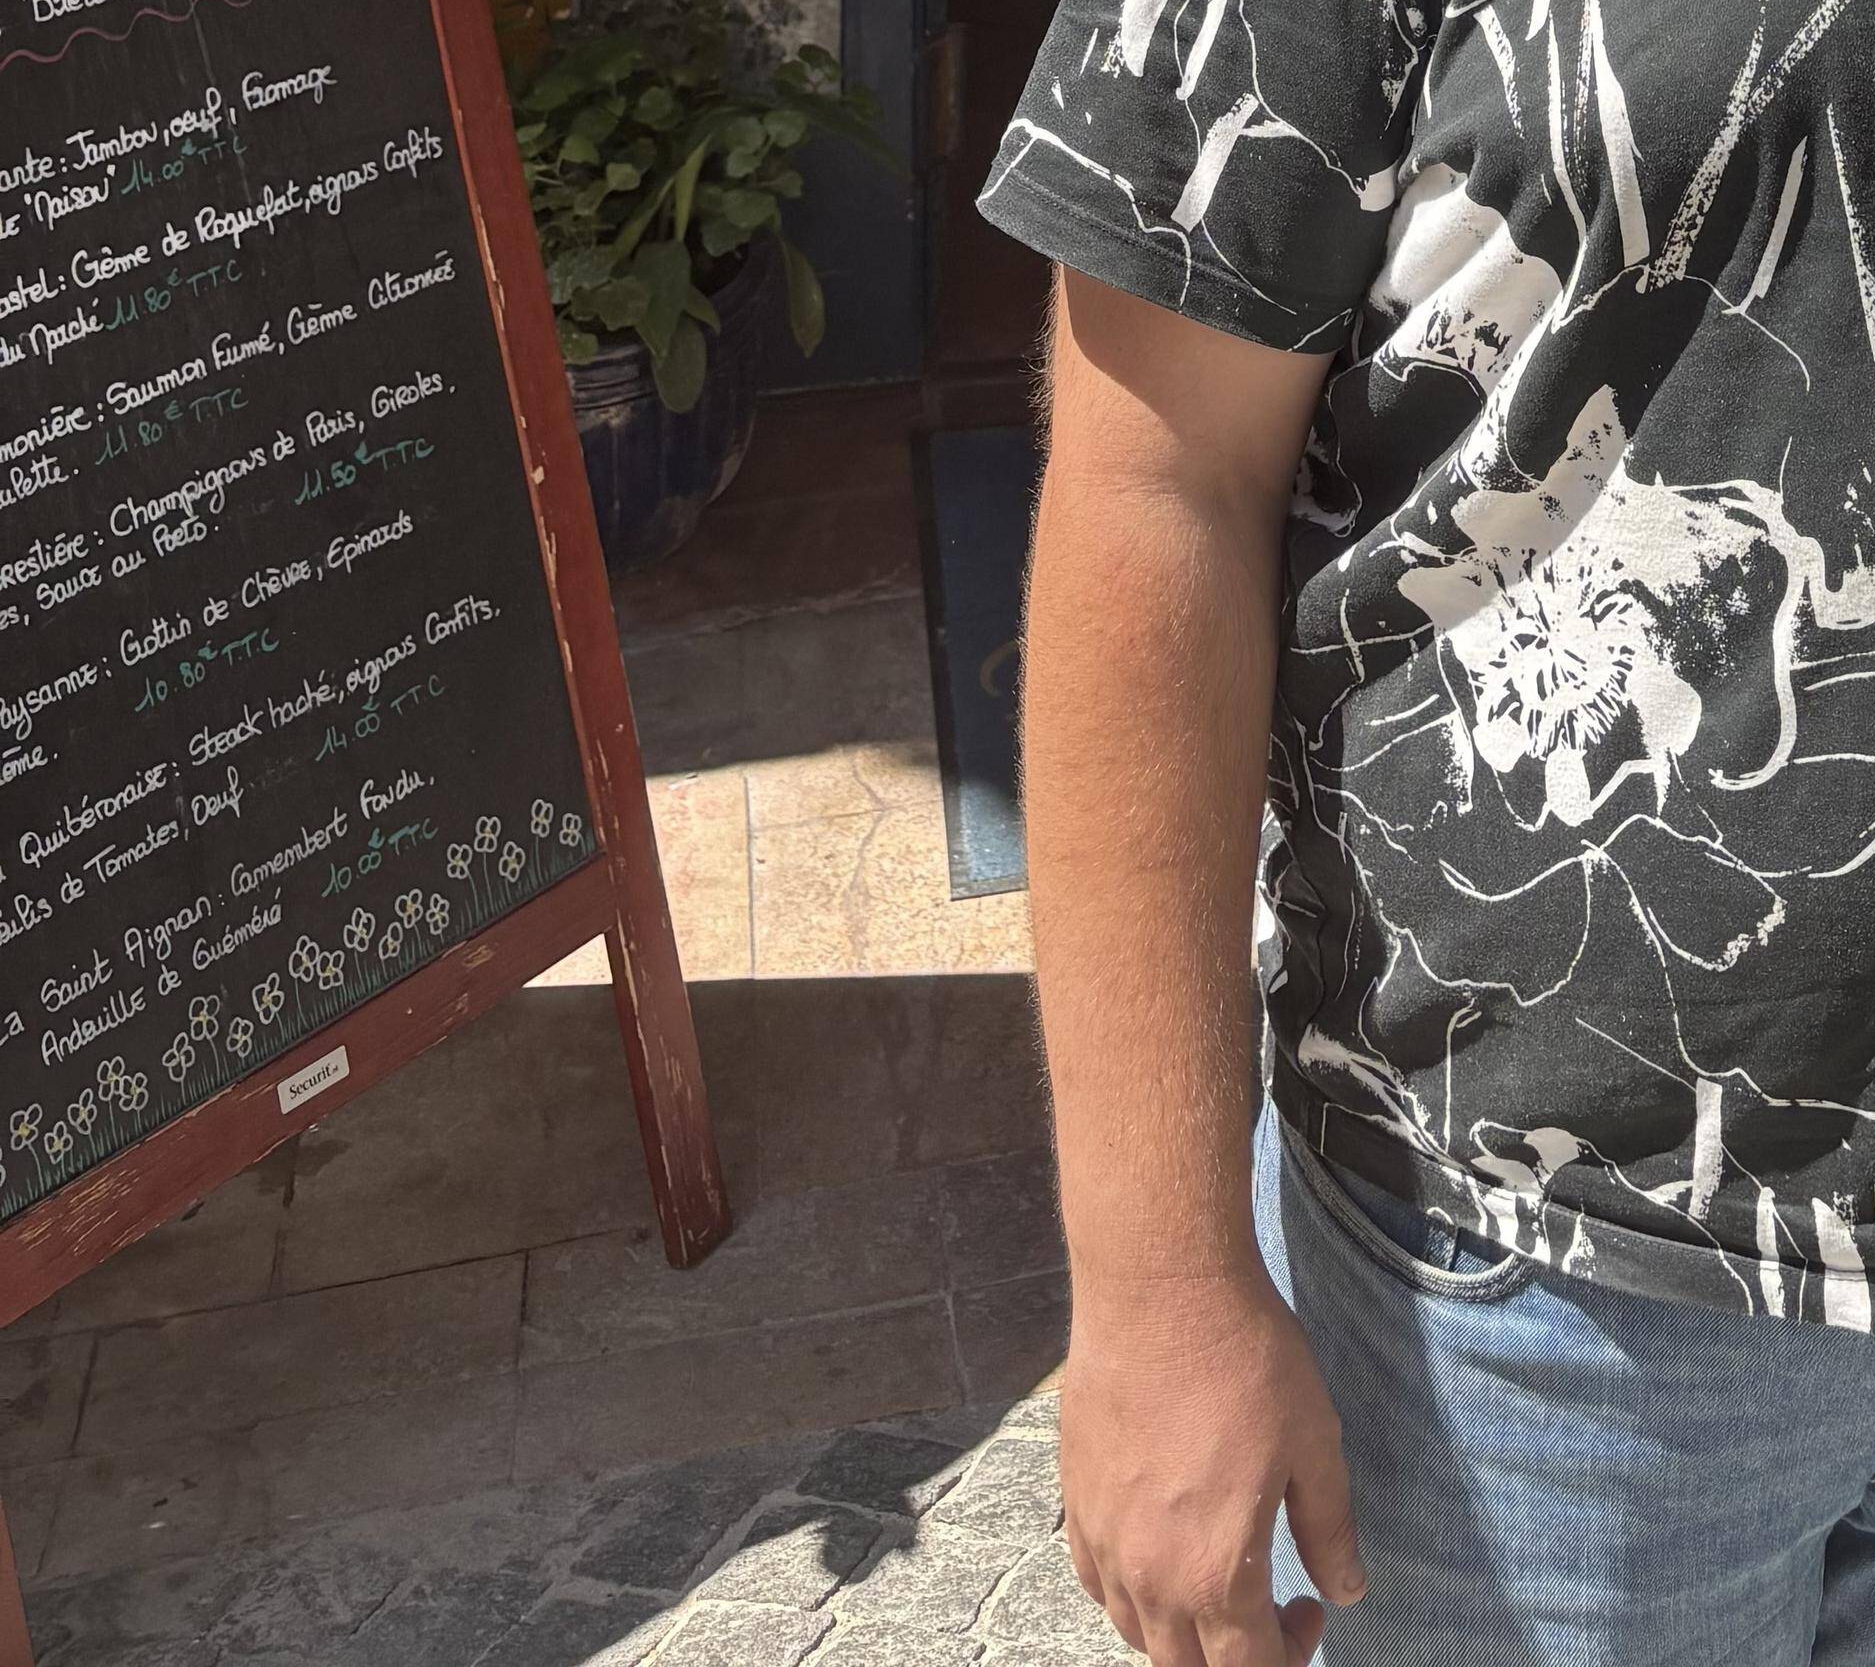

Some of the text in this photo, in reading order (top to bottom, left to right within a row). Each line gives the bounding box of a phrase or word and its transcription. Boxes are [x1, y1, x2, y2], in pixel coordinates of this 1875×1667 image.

[161, 225, 192, 258] de
[106, 357, 207, 419] Saumon
[272, 430, 296, 464] de
[112, 549, 146, 579] au
[202, 596, 230, 628] de
[61, 873, 86, 905] de
[40, 956, 113, 1015] Saint
[229, 806, 350, 897] Camembert
[157, 966, 183, 998] de
